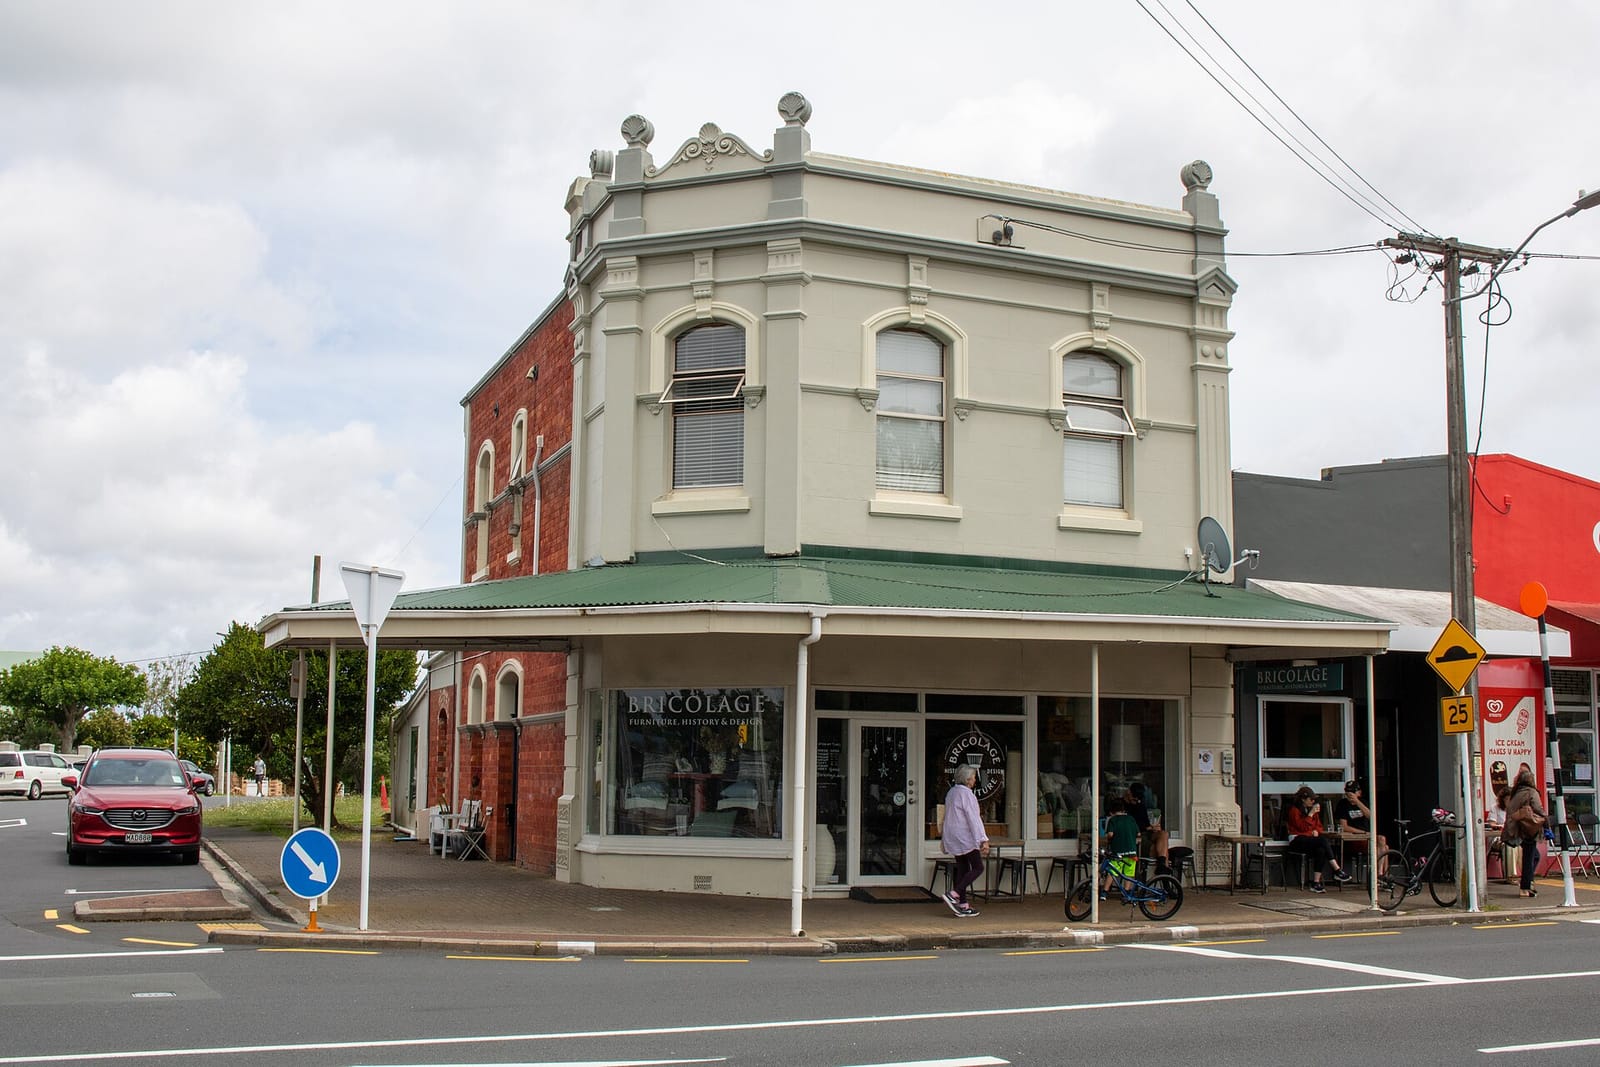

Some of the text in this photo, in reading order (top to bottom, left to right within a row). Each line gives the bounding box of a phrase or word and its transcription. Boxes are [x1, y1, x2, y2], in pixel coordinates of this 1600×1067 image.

[1257, 668, 1328, 684] BRICOLAGE
[628, 695, 766, 714] BRICOLAGE
[629, 718, 763, 726] FURNITURE, HISTORY & DESIGN
[1448, 704, 1468, 725] 25
[949, 736, 1001, 765] BRICOLAGE
[1488, 748, 1532, 756] MAKES U HAPPY
